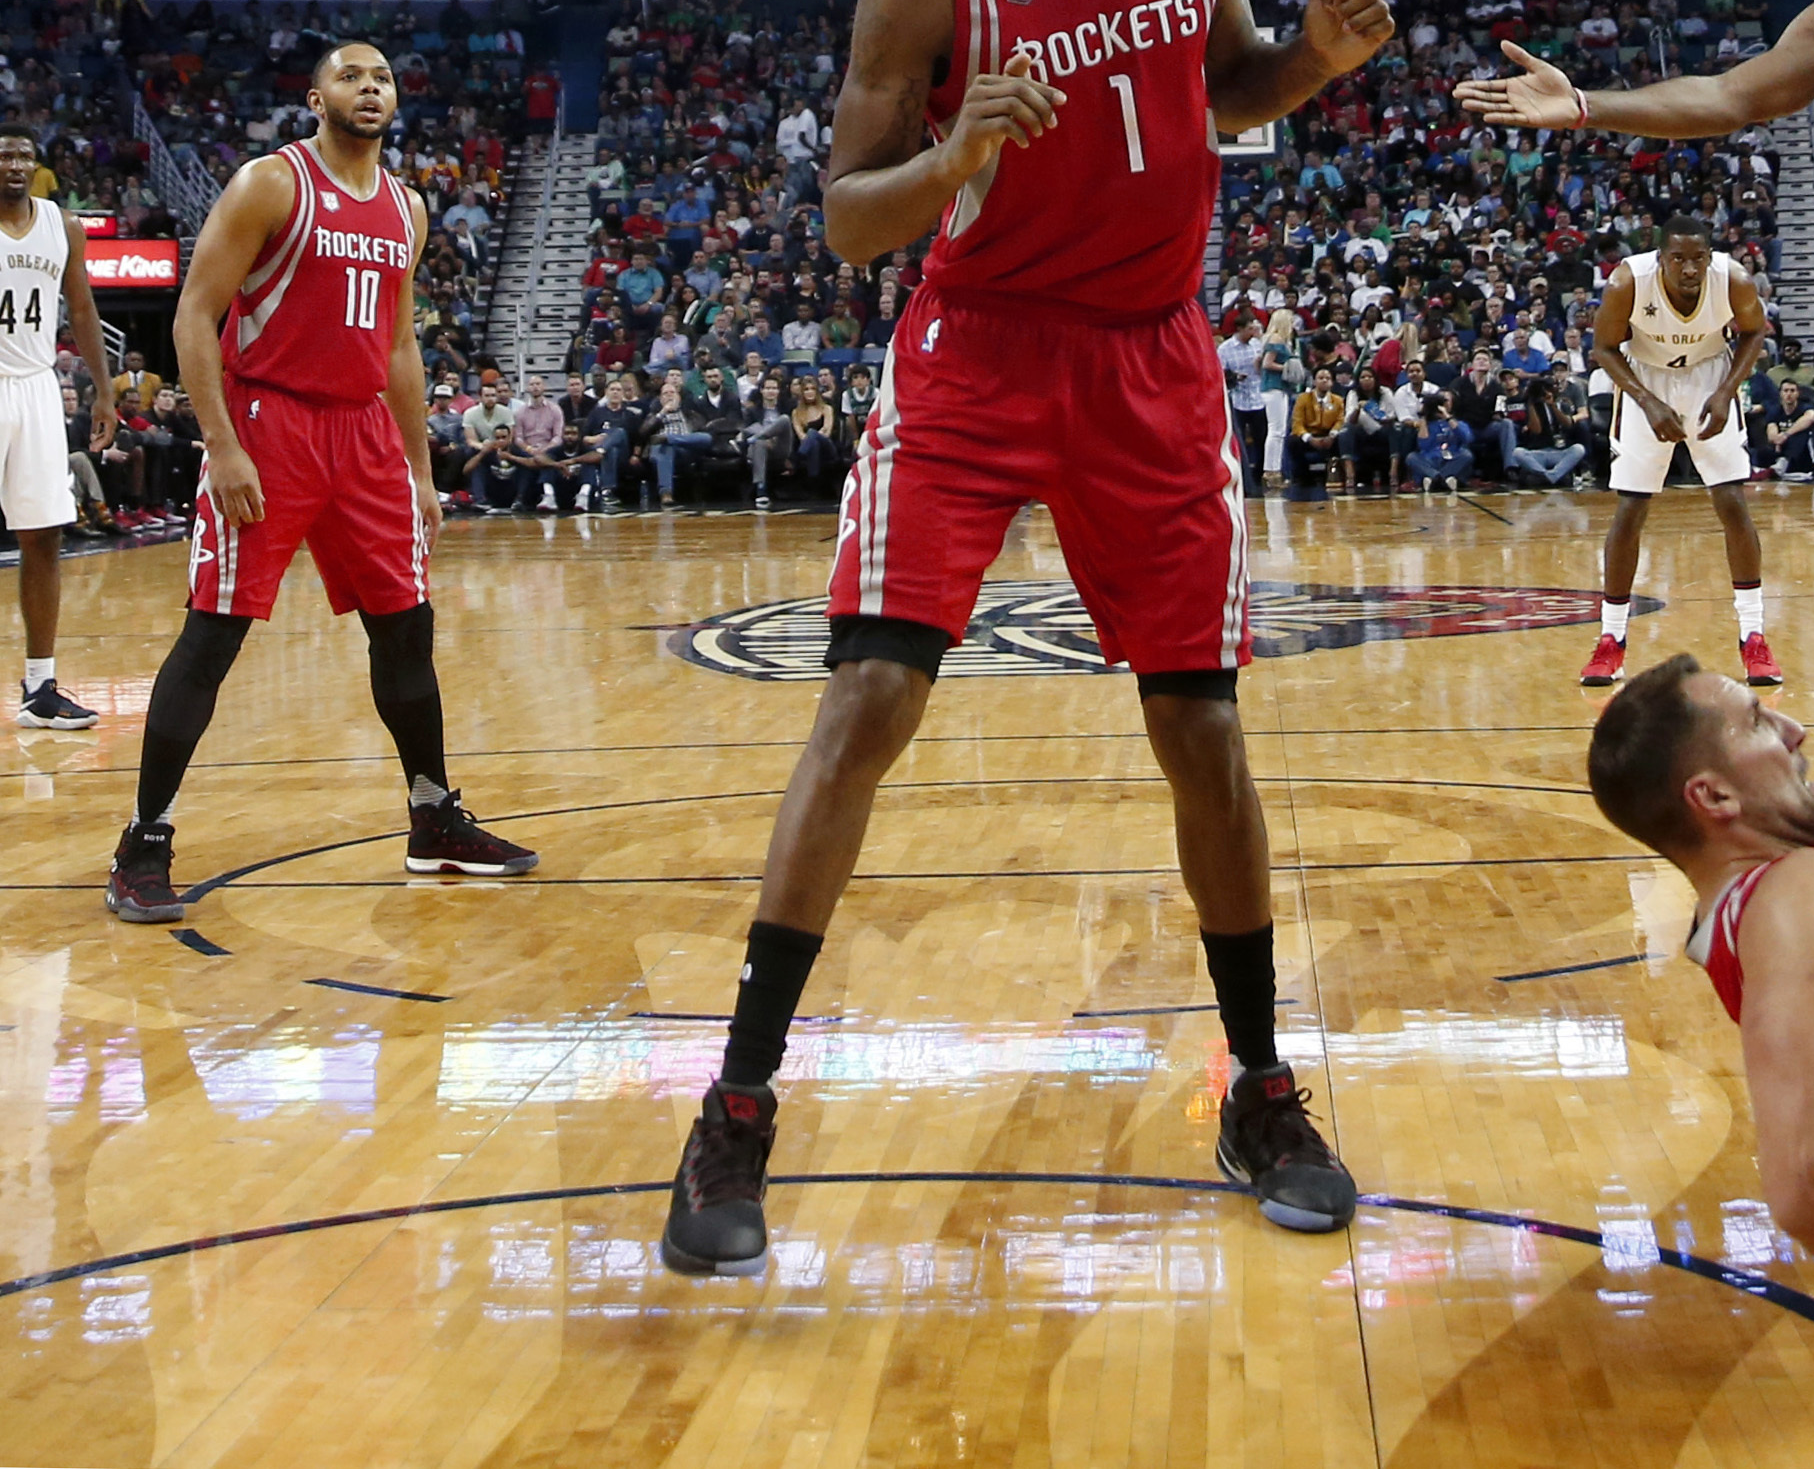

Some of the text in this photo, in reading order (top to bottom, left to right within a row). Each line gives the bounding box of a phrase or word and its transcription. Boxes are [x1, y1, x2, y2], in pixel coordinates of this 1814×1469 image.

[1108, 73, 1145, 173] 1
[314, 224, 409, 270] ROCKETS
[0, 288, 41, 335] 44
[345, 266, 381, 330] 10
